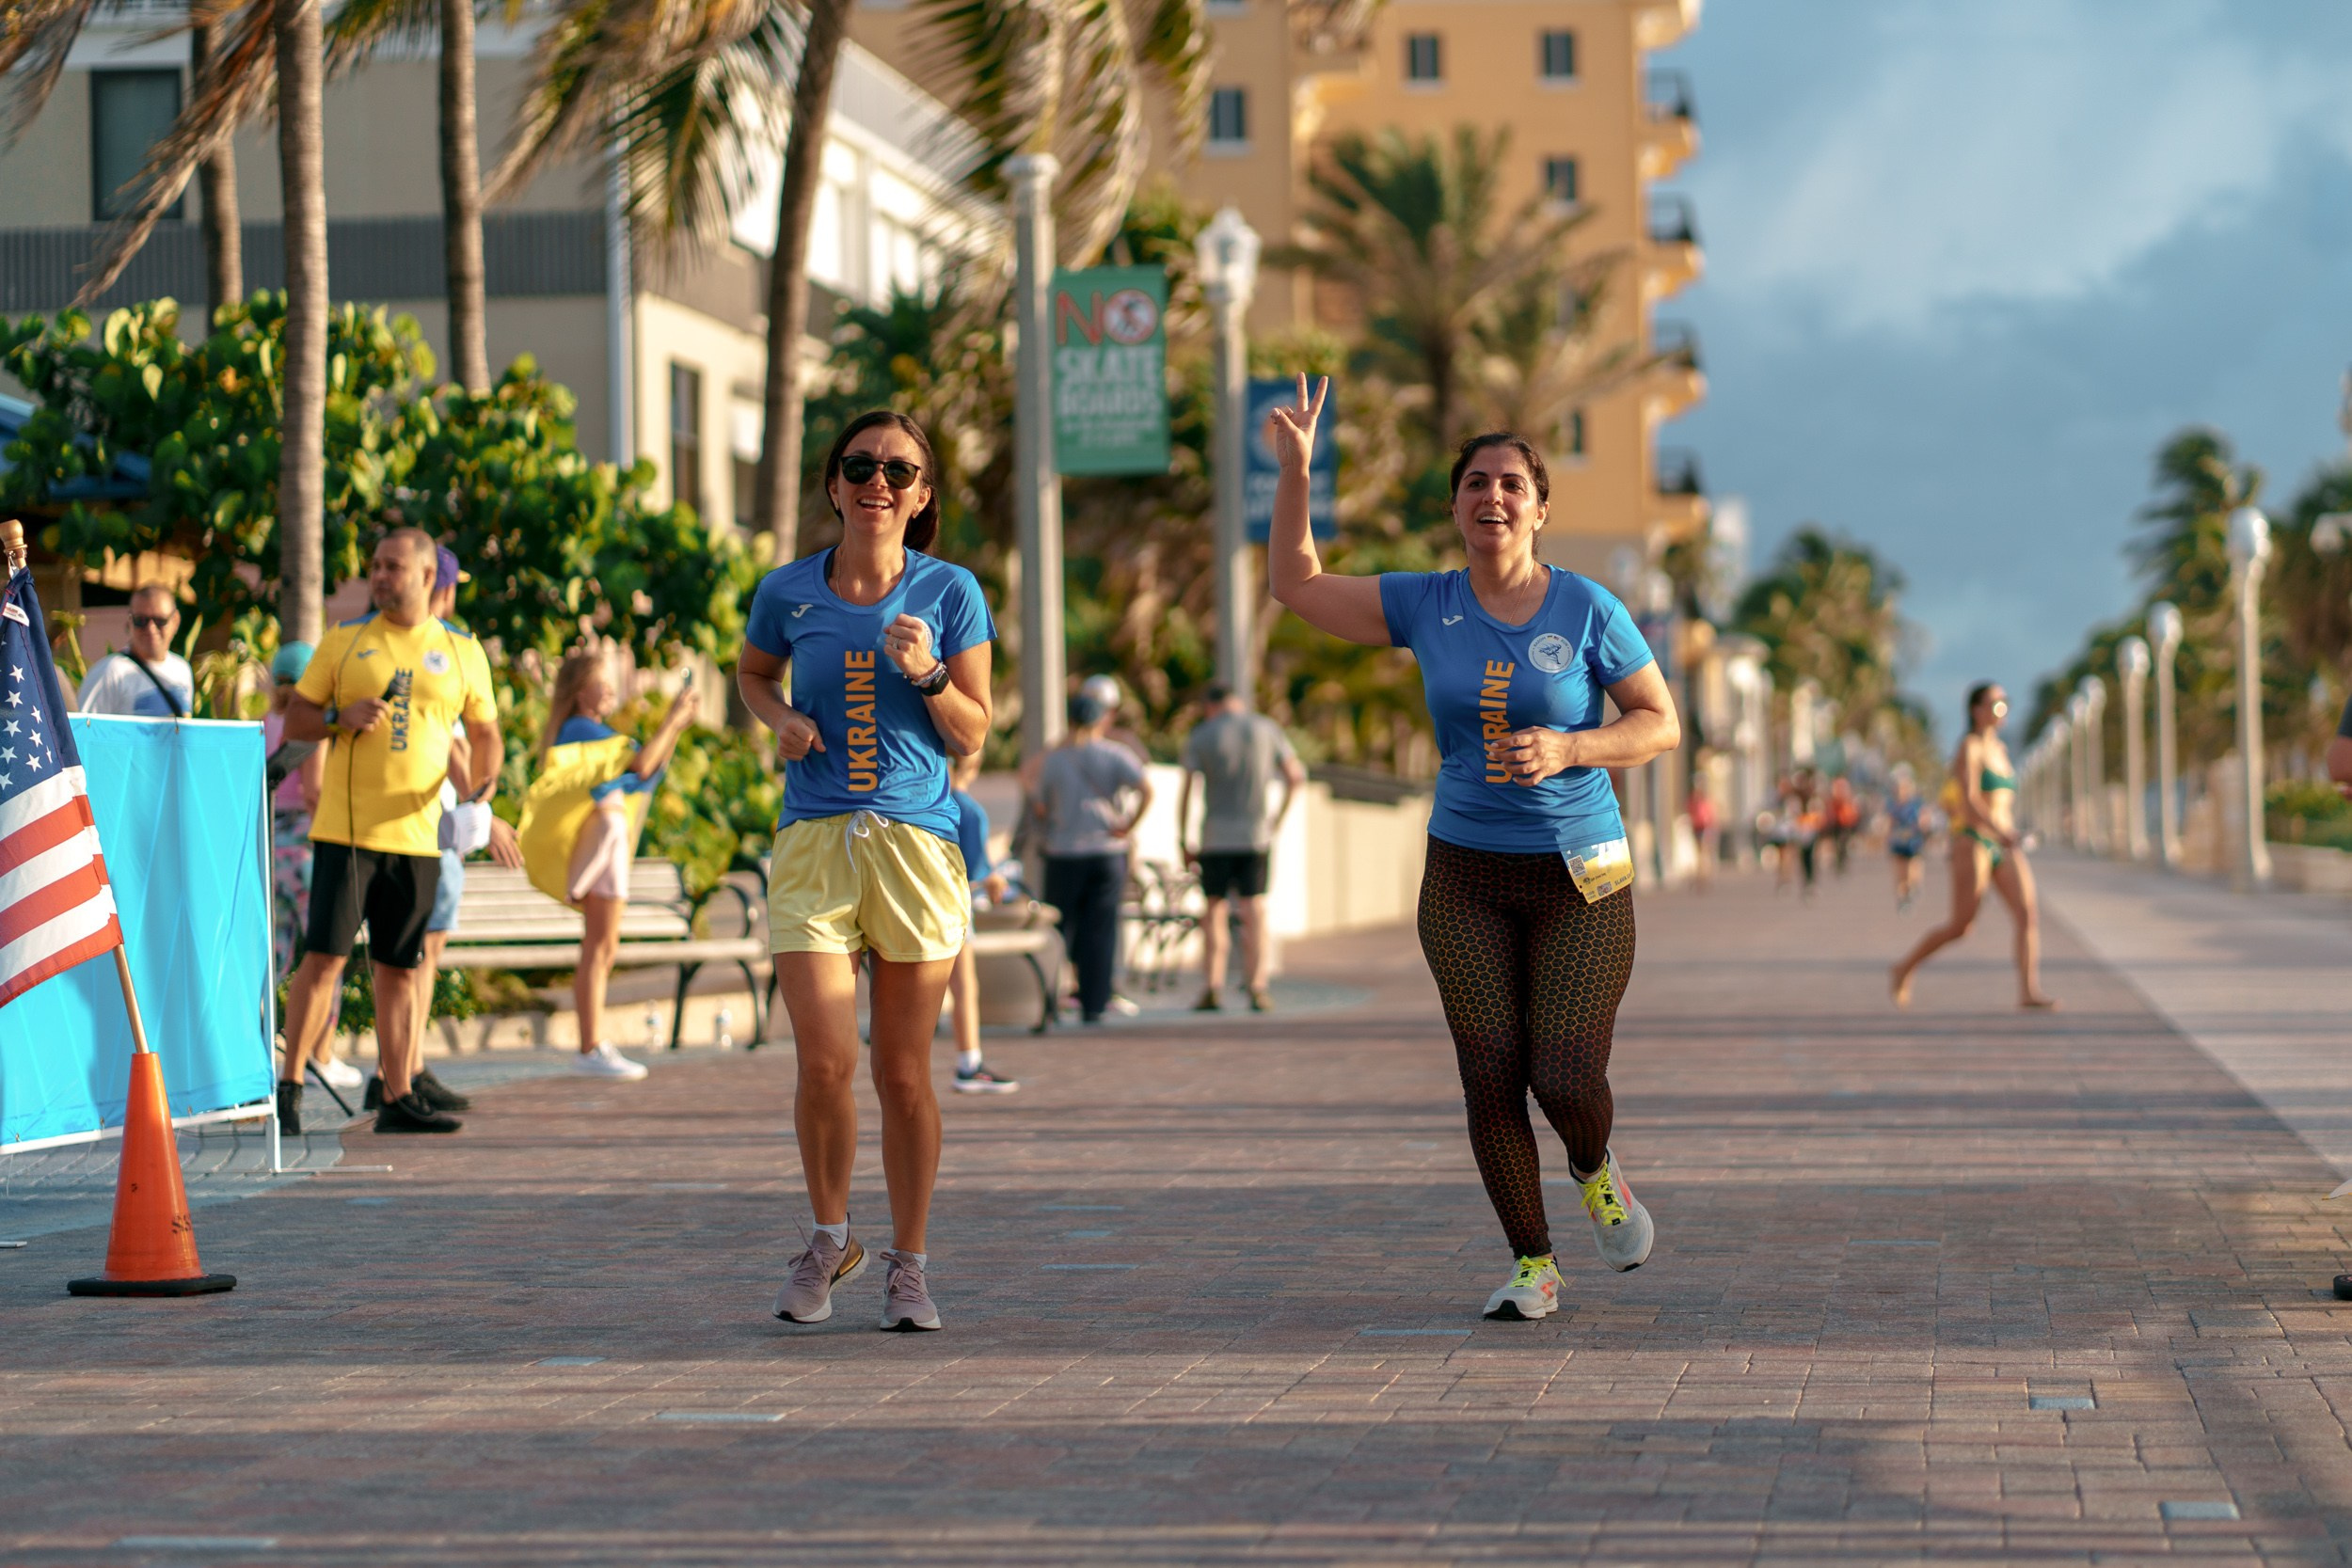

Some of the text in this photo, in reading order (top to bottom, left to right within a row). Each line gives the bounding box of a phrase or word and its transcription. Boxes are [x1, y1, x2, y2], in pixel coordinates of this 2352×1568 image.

[1056, 289, 1158, 346] NO
[1057, 348, 1161, 382] SKATE
[845, 650, 878, 791] UKRAINE
